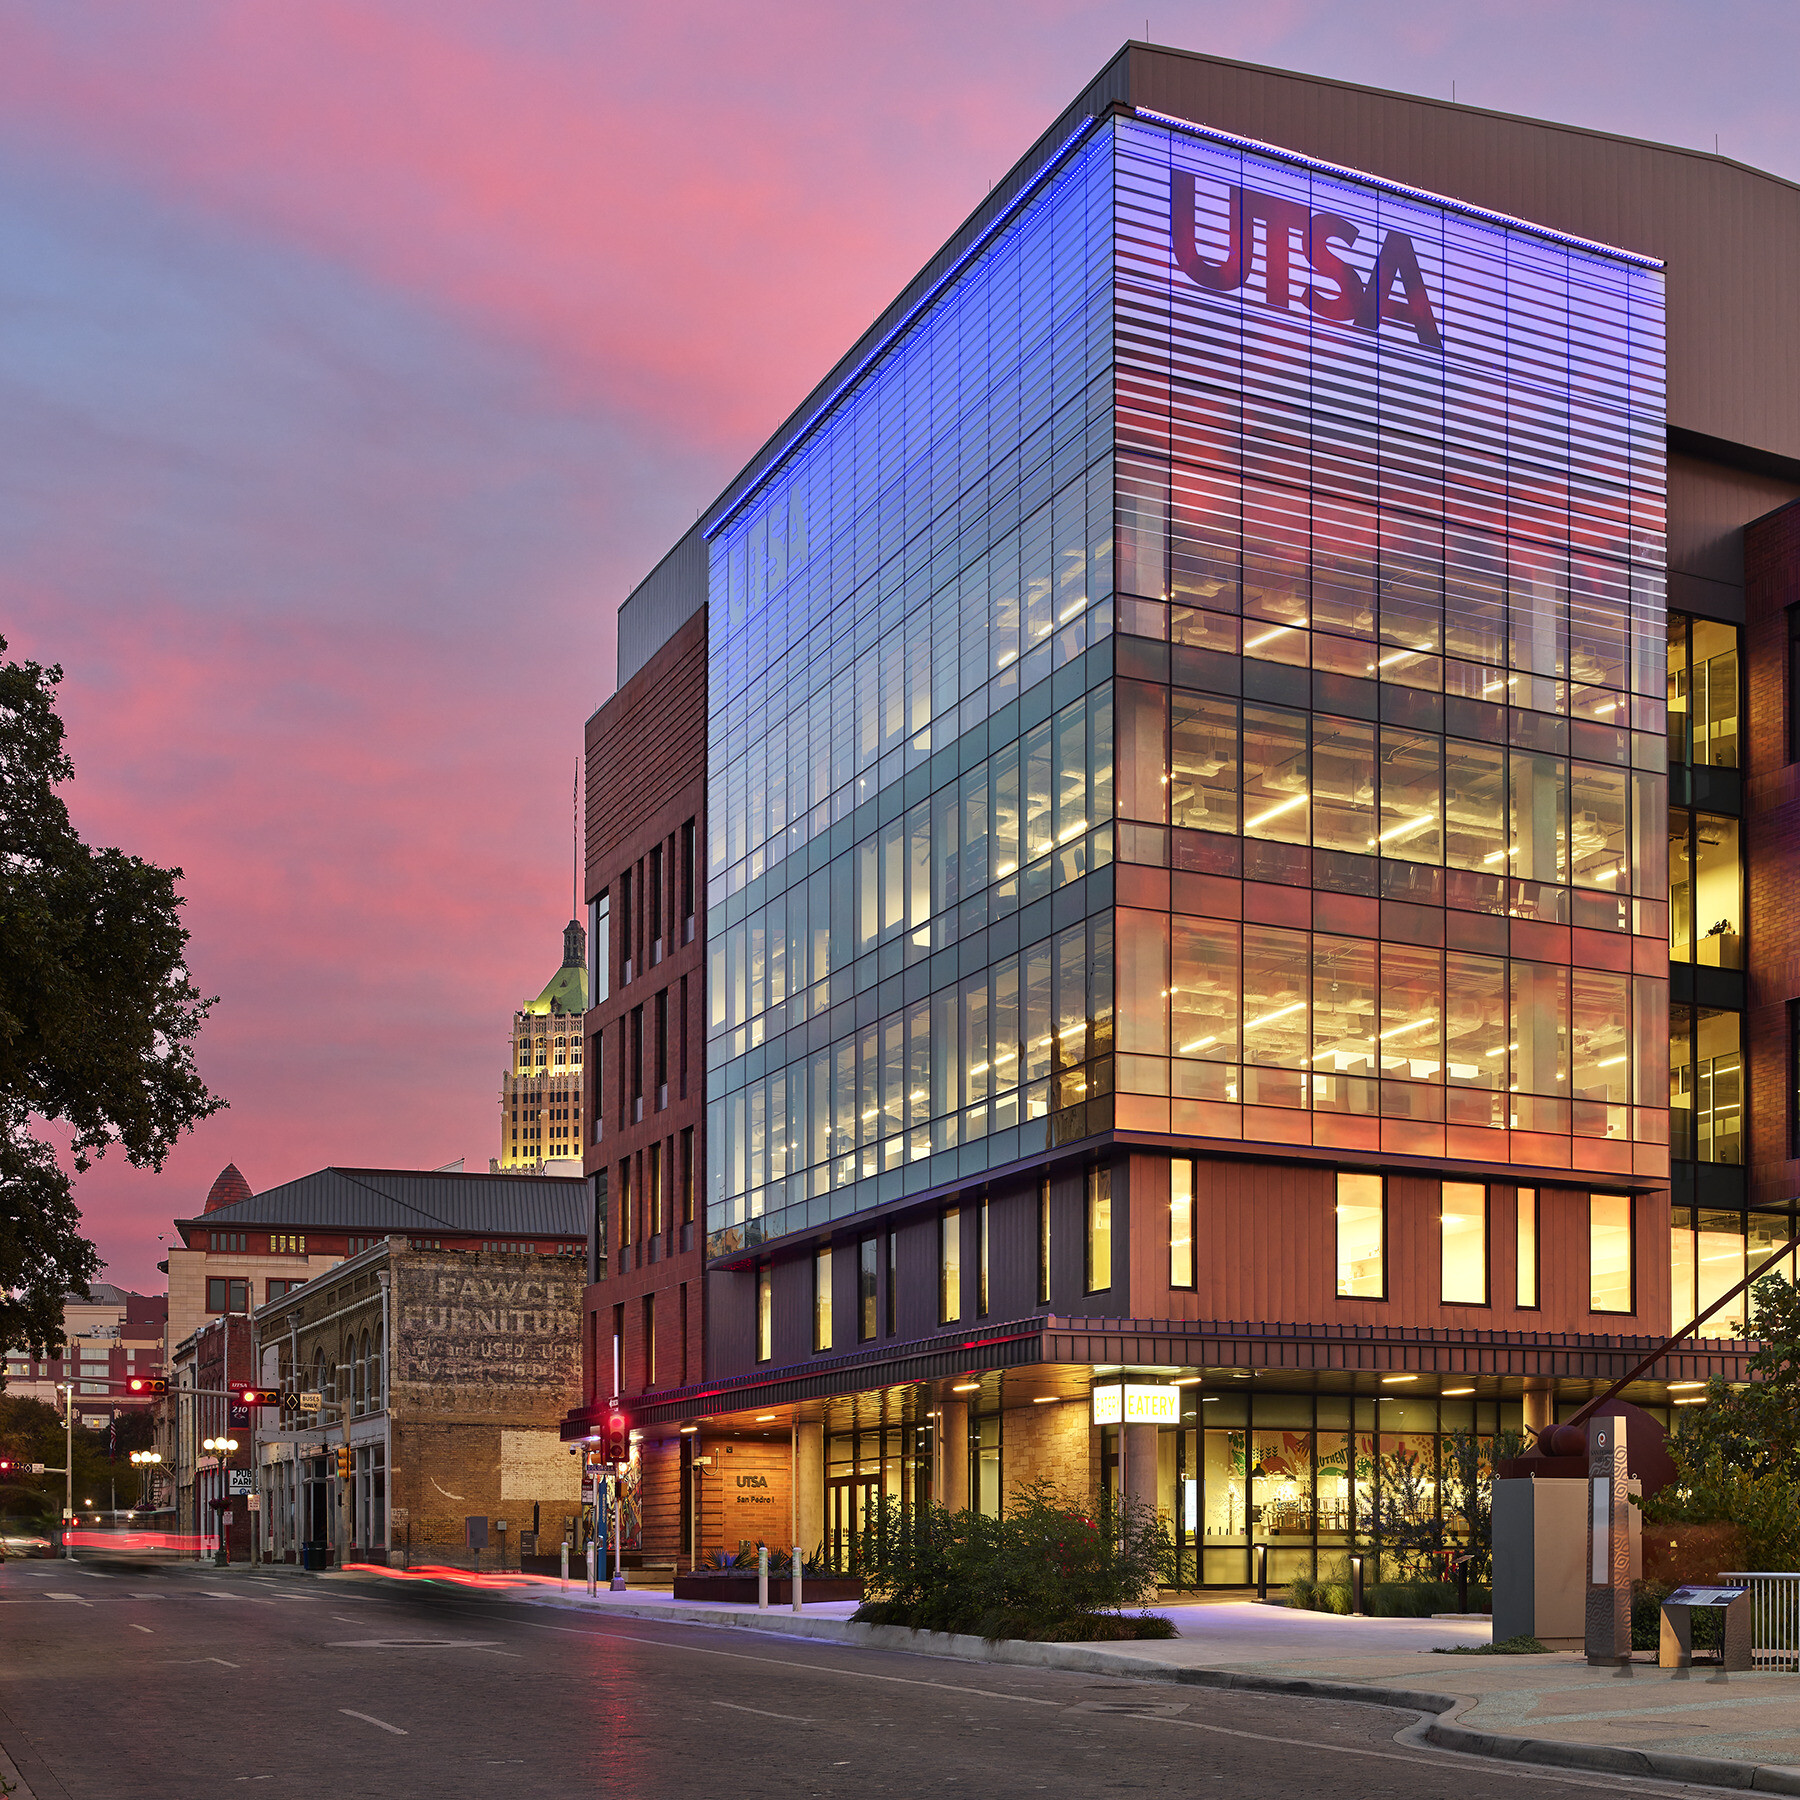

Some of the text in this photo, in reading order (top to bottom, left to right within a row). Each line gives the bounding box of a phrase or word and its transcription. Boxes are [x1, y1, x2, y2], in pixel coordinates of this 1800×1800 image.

[1170, 168, 1444, 348] UTSA
[438, 1276, 566, 1304] FAWCE
[404, 1305, 580, 1335] FURNITUR
[1096, 1396, 1120, 1417] EATERY
[1128, 1395, 1176, 1416] EATERY
[736, 1475, 768, 1488] UTSA
